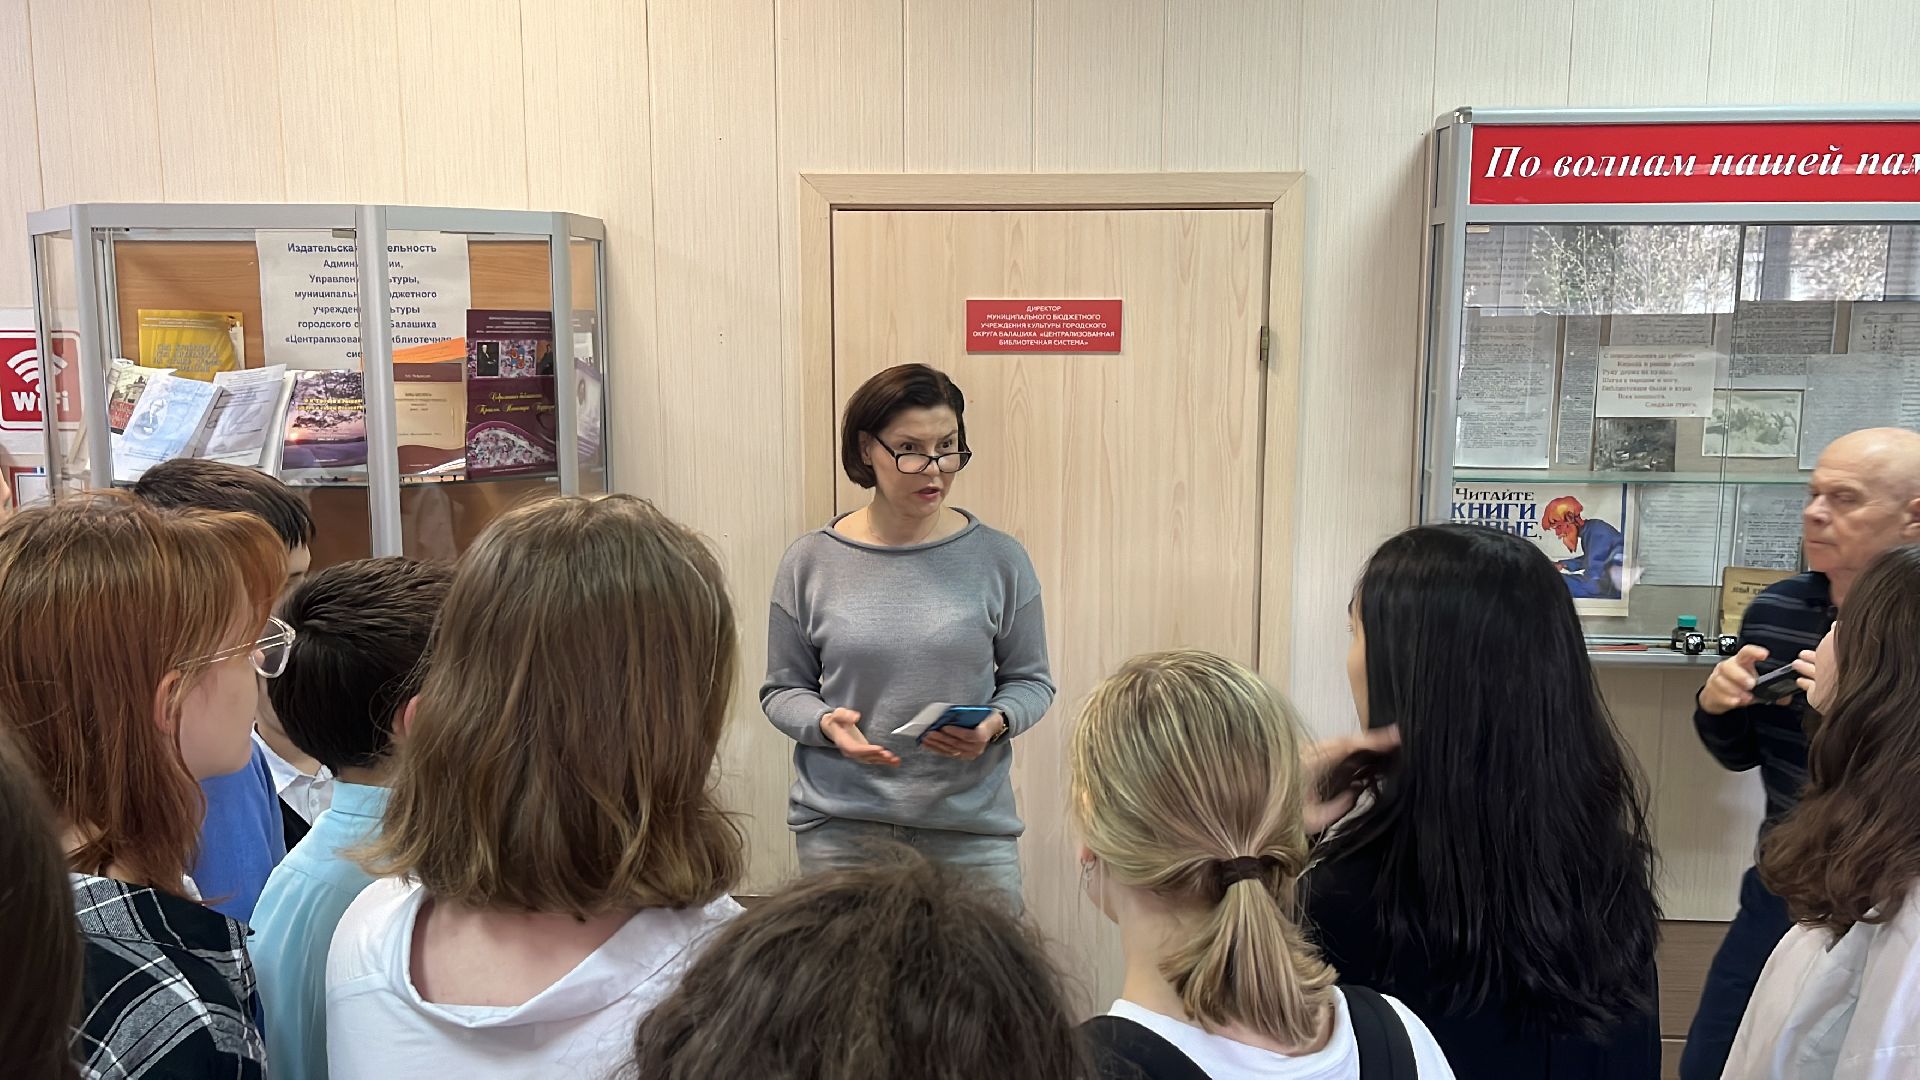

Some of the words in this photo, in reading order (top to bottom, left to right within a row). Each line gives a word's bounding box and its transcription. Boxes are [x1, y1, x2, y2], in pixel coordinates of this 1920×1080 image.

[1484, 146, 1540, 178] По
[1553, 154, 1696, 177] волнам
[1709, 144, 1843, 176] нашей
[288, 243, 357, 253] Издательска
[309, 274, 358, 284] Управлен
[294, 291, 358, 301] муниципальн
[390, 291, 437, 299] джетного
[313, 306, 361, 315] учрежден
[298, 321, 352, 330] городского
[285, 335, 361, 344] «Централизова
[11, 390, 69, 411] Wii
[1451, 503, 1536, 519] КНИГИ
